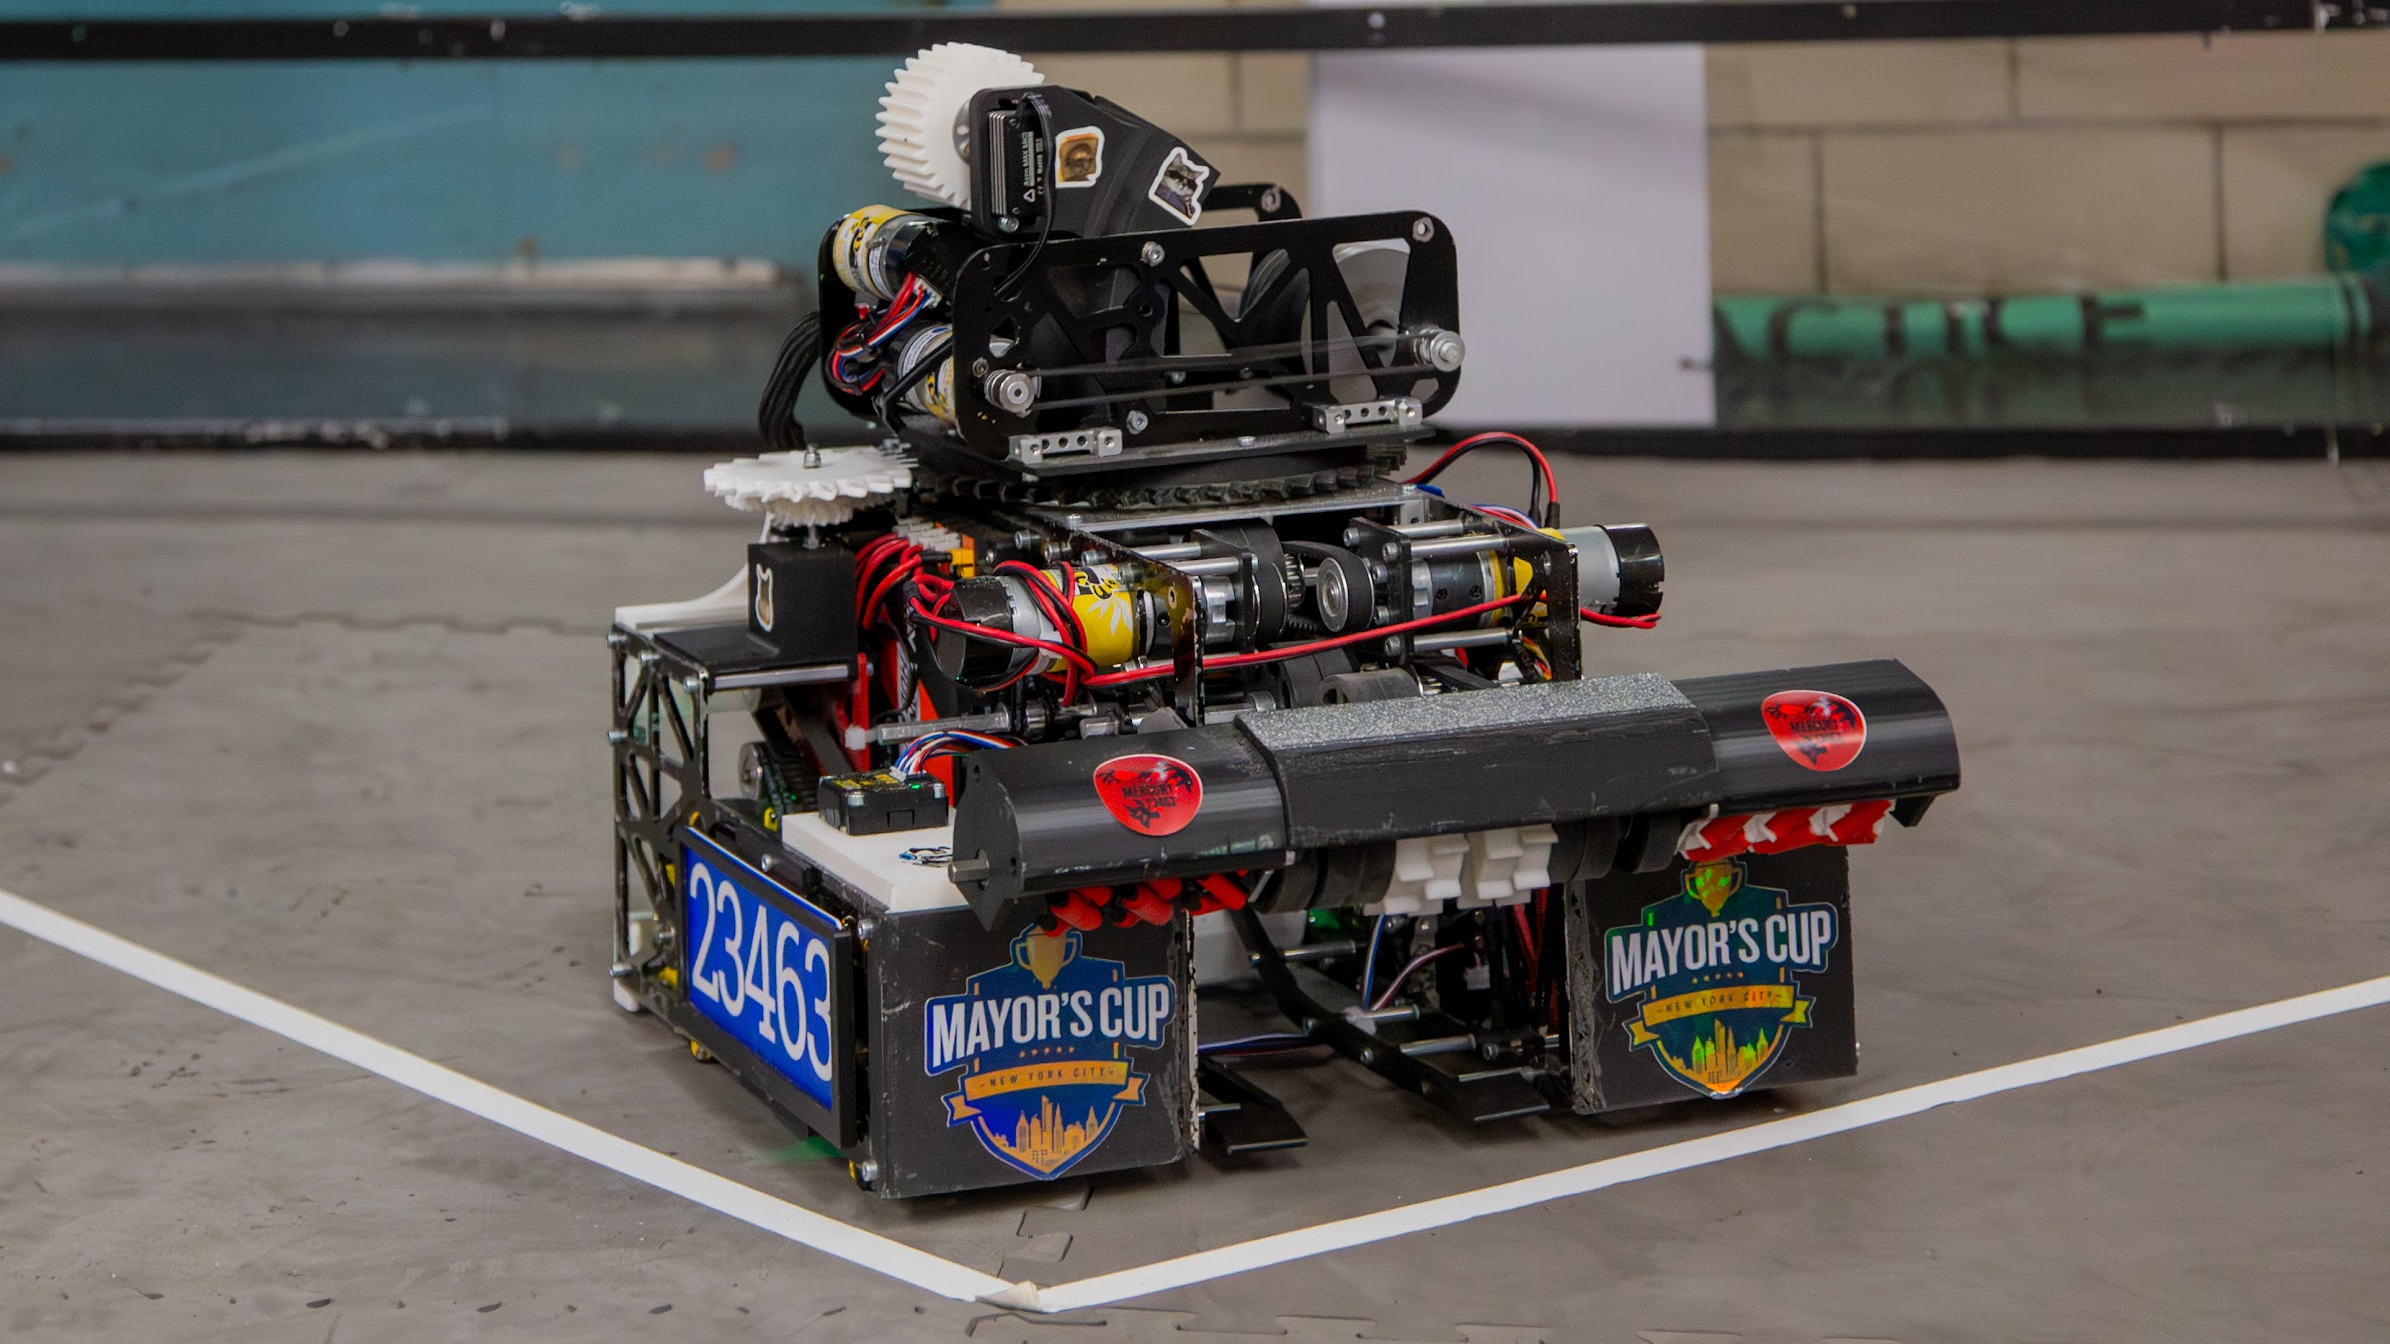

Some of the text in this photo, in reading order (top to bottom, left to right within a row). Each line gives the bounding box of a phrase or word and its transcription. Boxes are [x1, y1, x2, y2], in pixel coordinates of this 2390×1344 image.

[690, 862, 833, 1081] 23463
[1611, 910, 1832, 996] MAYOR'S CUP
[932, 983, 1170, 1068] MAYOR'S CUP
[989, 1066, 1106, 1088] NEW YORK CITY
